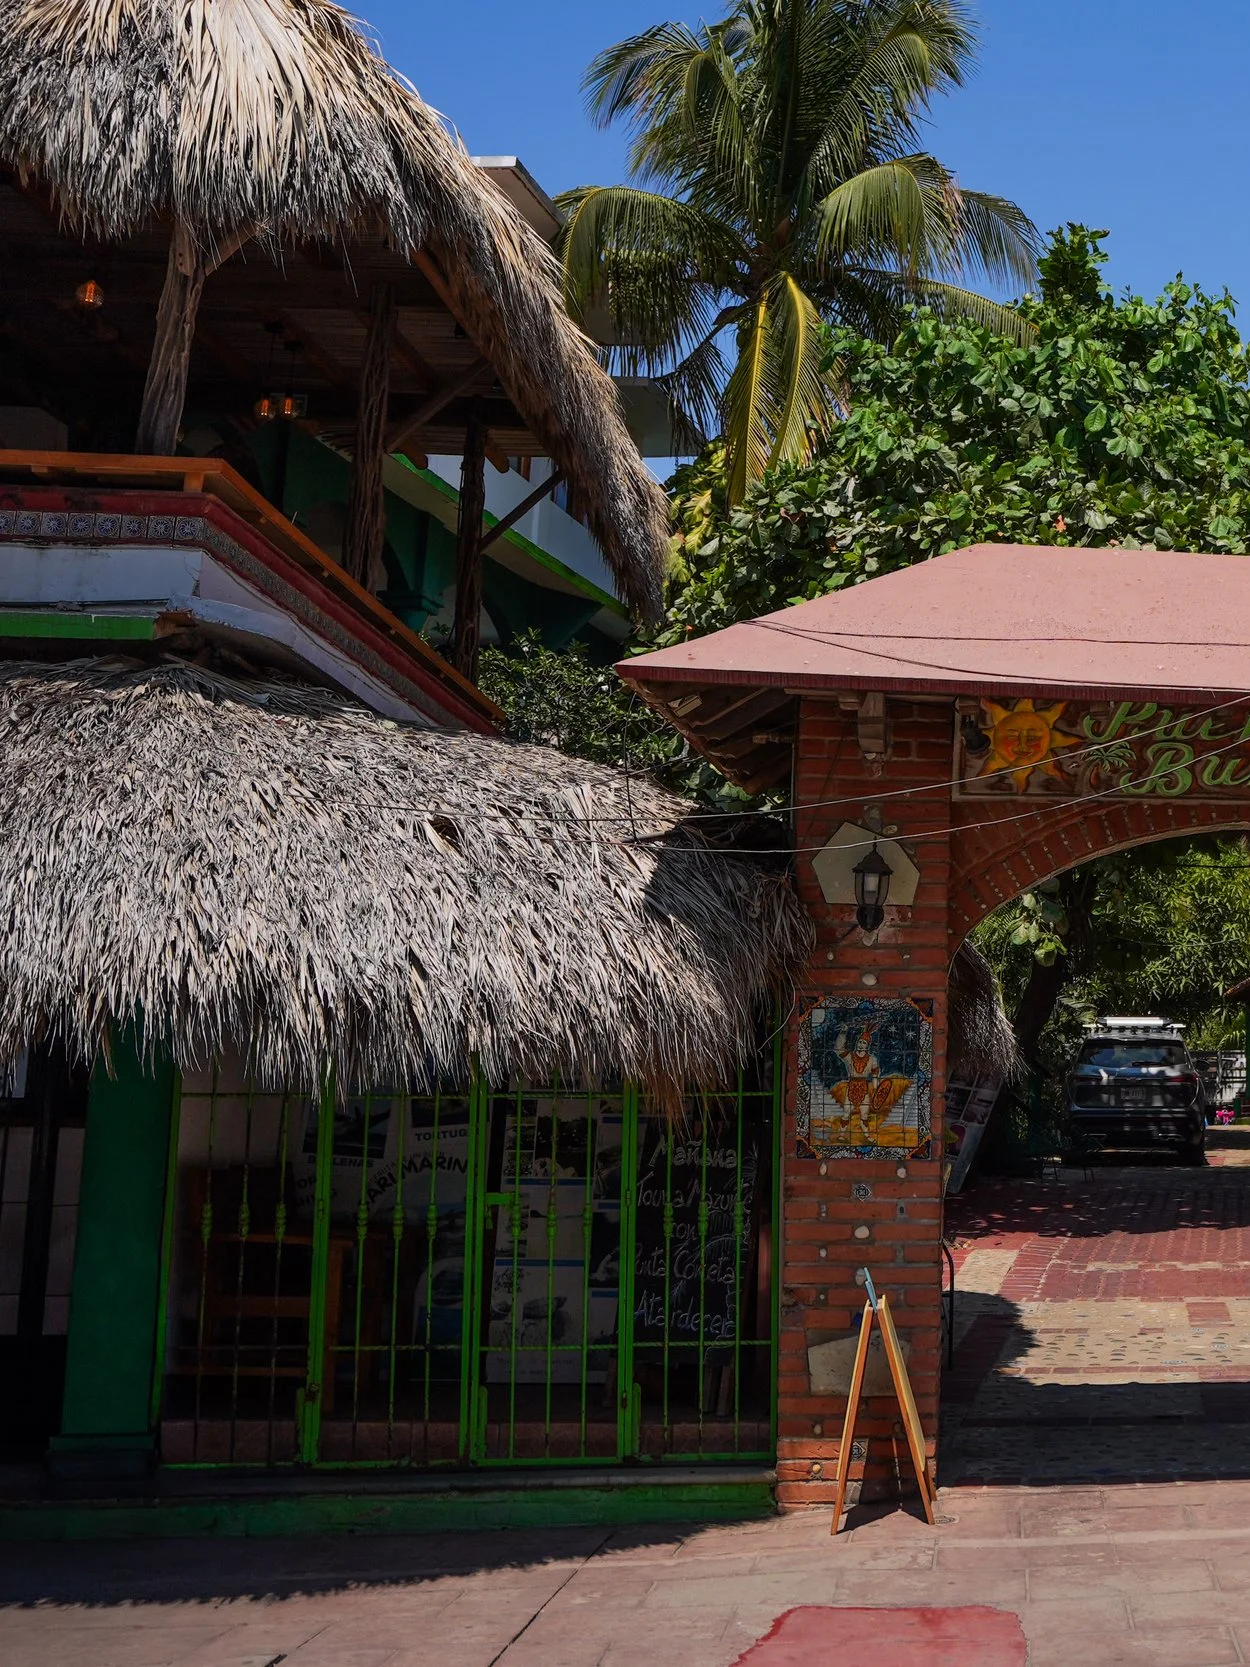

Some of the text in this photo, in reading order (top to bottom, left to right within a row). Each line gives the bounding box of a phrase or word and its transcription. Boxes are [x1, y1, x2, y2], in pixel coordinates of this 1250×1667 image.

[415, 1128, 477, 1142] TORTUG
[308, 1155, 374, 1168] BLENAS
[401, 1157, 468, 1179] MARIN
